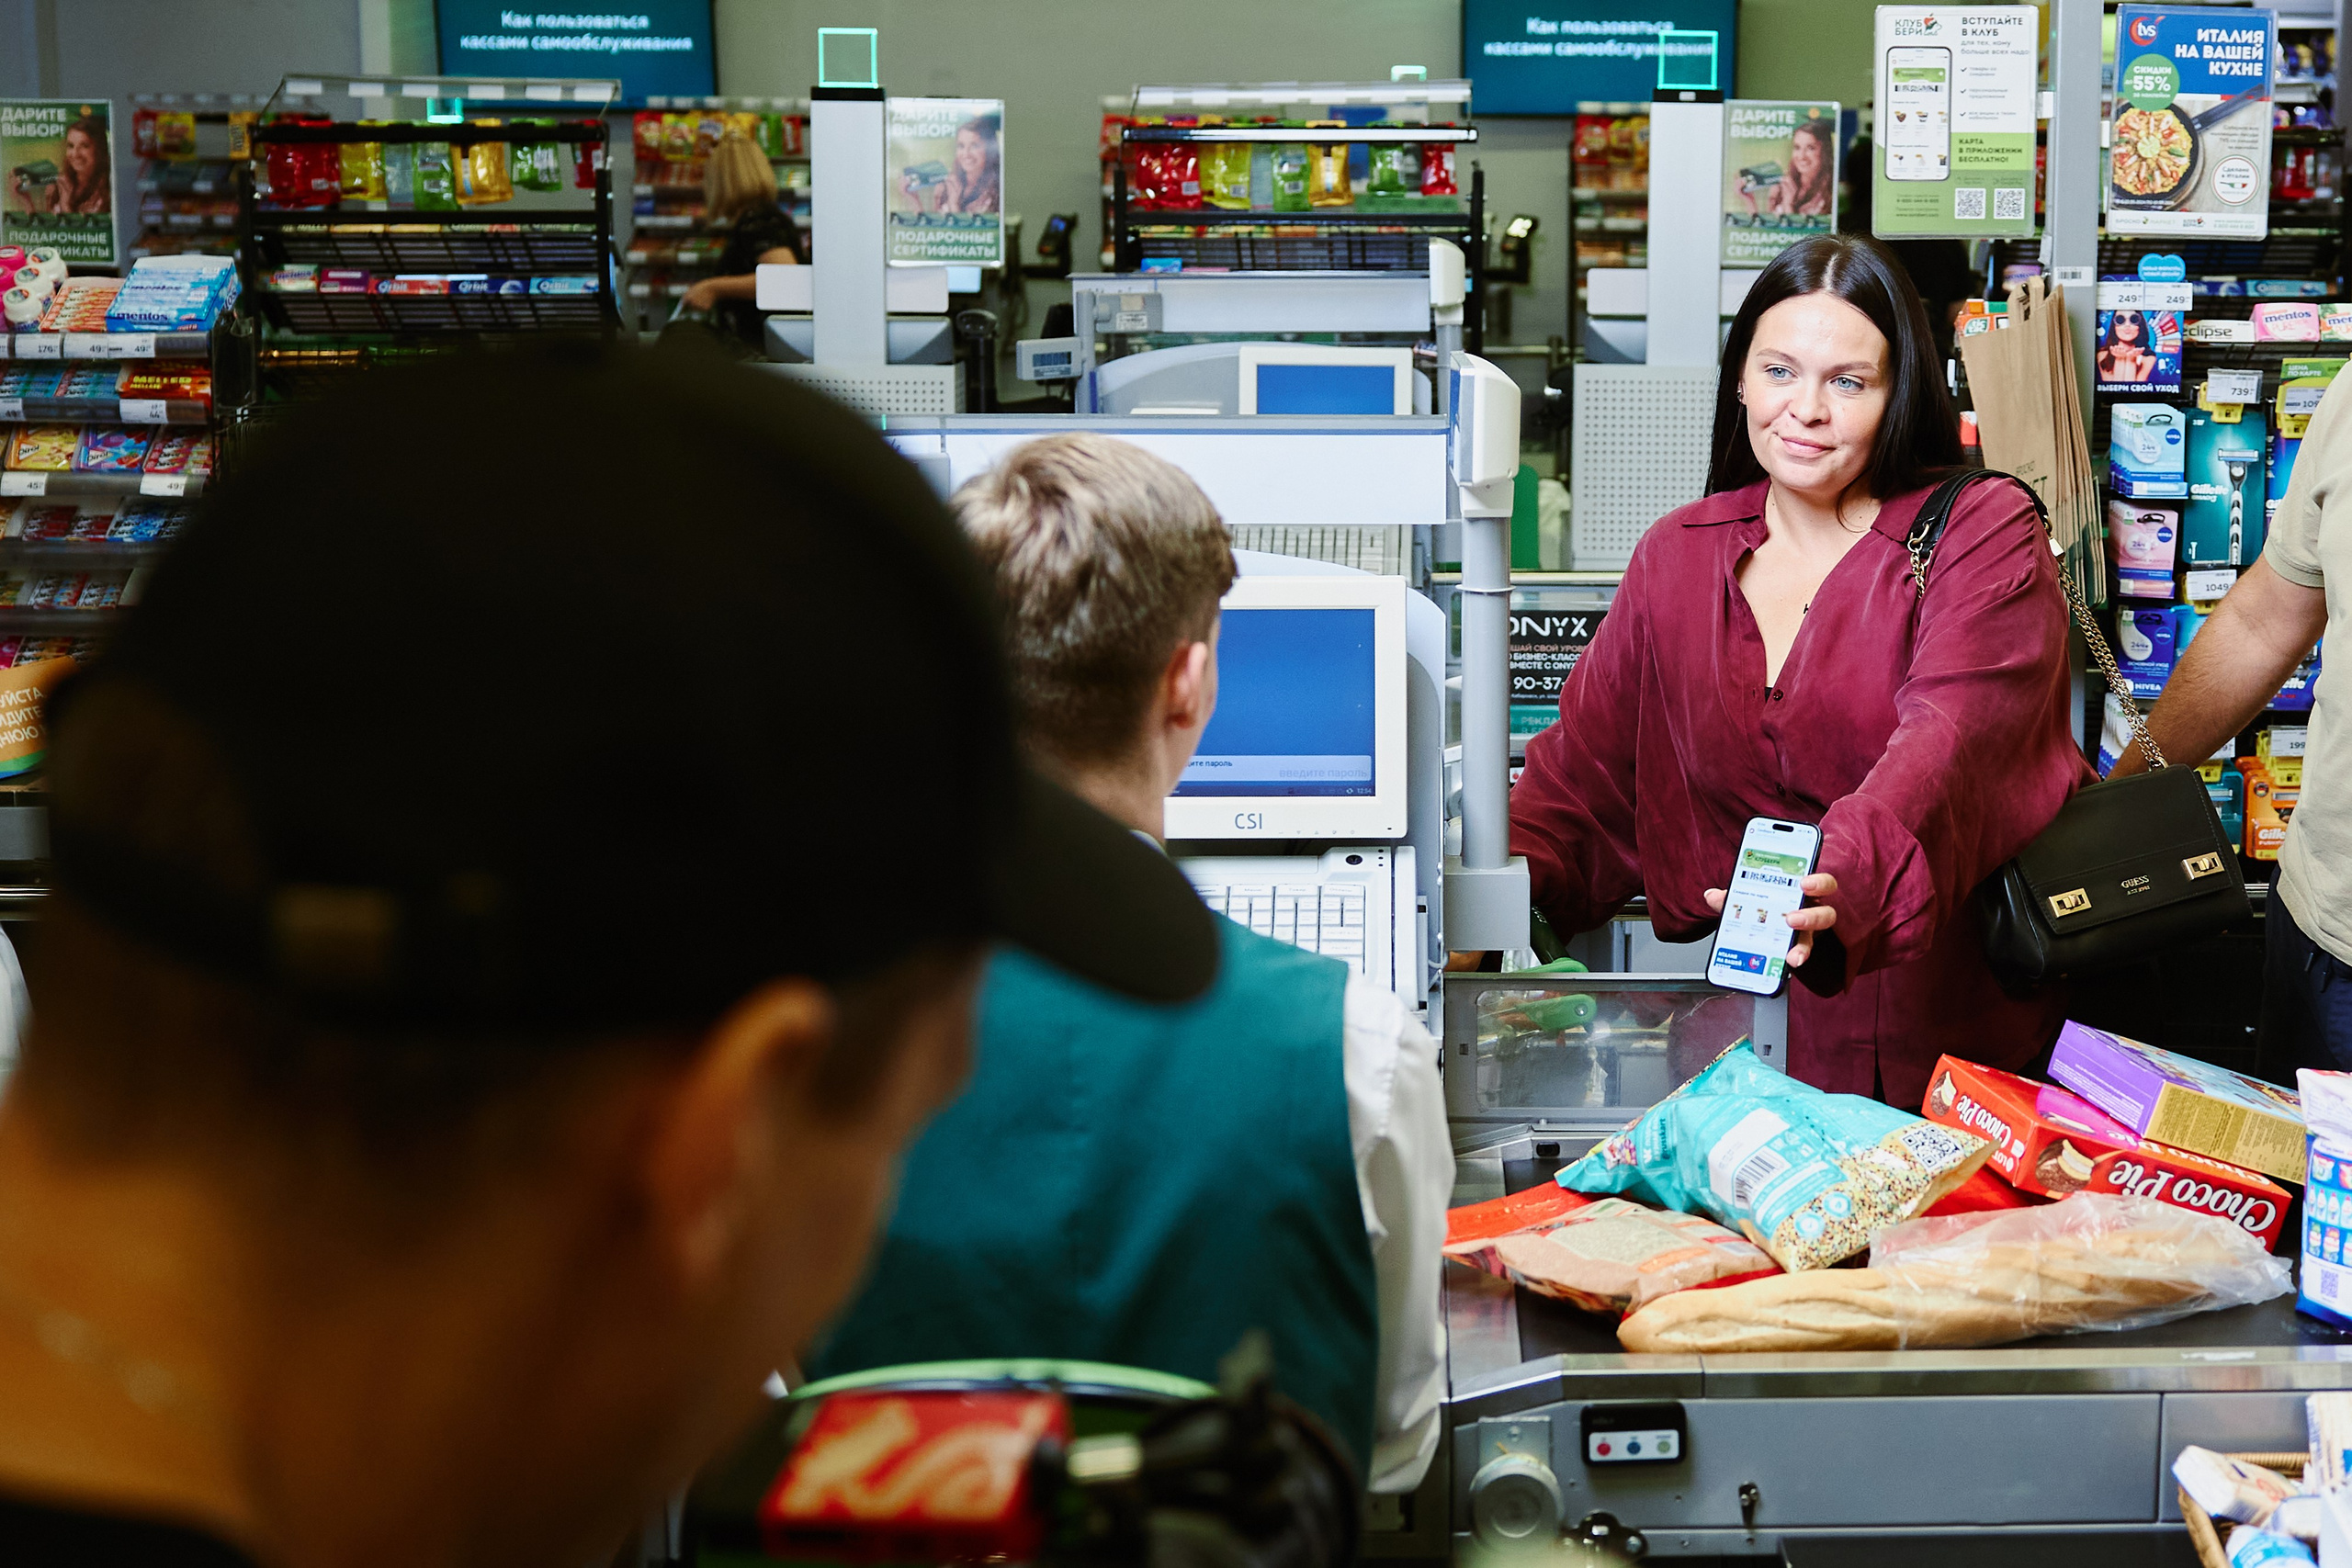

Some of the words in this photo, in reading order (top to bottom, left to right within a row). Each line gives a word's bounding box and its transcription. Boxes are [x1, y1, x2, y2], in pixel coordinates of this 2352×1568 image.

[501, 10, 533, 28] Как
[536, 15, 650, 29] пользоваться
[1526, 17, 1559, 34] Как
[1894, 19, 1923, 28] КЛУБ
[1962, 15, 2024, 26] ВСТУПАЙТЕ
[1894, 28, 1923, 36] БЕРИ
[1962, 28, 1968, 37] В
[1971, 28, 1999, 37] КЛУБ
[2137, 20, 2156, 38] tvs
[2197, 28, 2265, 44] ИТАЛИЯ
[460, 35, 529, 50] кассами
[531, 33, 693, 54] самообслуживания
[1484, 41, 1553, 56] кассами
[2175, 44, 2199, 59] НА
[2202, 43, 2264, 61] ВАШЕЙ
[2132, 66, 2172, 74] СКИДКИ
[2209, 61, 2264, 76] КУХНЕ
[2132, 75, 2171, 91] 55%
[1, 107, 67, 122] ДАРИТЕ
[892, 109, 957, 122] ДАРИТЕ
[1730, 109, 1796, 123] ДАРИТЕ
[1, 123, 65, 138] ВЫБОР!
[891, 123, 956, 137] ВЫБОР!
[1730, 125, 1792, 139] ВЫБОР!
[9, 231, 107, 243] ПОДАРОЧНЫЕ
[895, 231, 994, 243] ПОДАРОЧНЫЕ
[893, 244, 996, 257] СЕРТИФИКАТЫ
[2118, 294, 2137, 303] 249
[2166, 295, 2185, 304] 249
[115, 312, 168, 321] mentos
[2265, 310, 2312, 323] mentos
[2097, 384, 2130, 392] ВЫБЕРИ
[2131, 382, 2154, 392] СВОЙ
[2154, 384, 2180, 394] УХОД
[2231, 387, 2250, 396] 739
[2190, 483, 2229, 495] Gillette
[1533, 643, 1559, 652] СВОЙ
[1510, 661, 1544, 670] ВМЕСТЕ
[2134, 682, 2162, 691] NIVEA
[1521, 716, 1560, 726] РЕКЛА
[0, 725, 39, 749] НЮЮ
[1204, 761, 1233, 769] пароль
[1279, 769, 1324, 780] введите
[1327, 770, 1368, 780] пароль
[1234, 813, 1263, 829] CSI
[2120, 874, 2150, 889] GUESS
[1956, 1095, 1981, 1127] Pie
[1976, 1108, 2012, 1149] Choco
[2107, 1130, 2165, 1155] Pie
[2167, 1147, 2271, 1186] Choco
[2108, 1159, 2175, 1201] Pie
[2172, 1178, 2277, 1232] Choco
